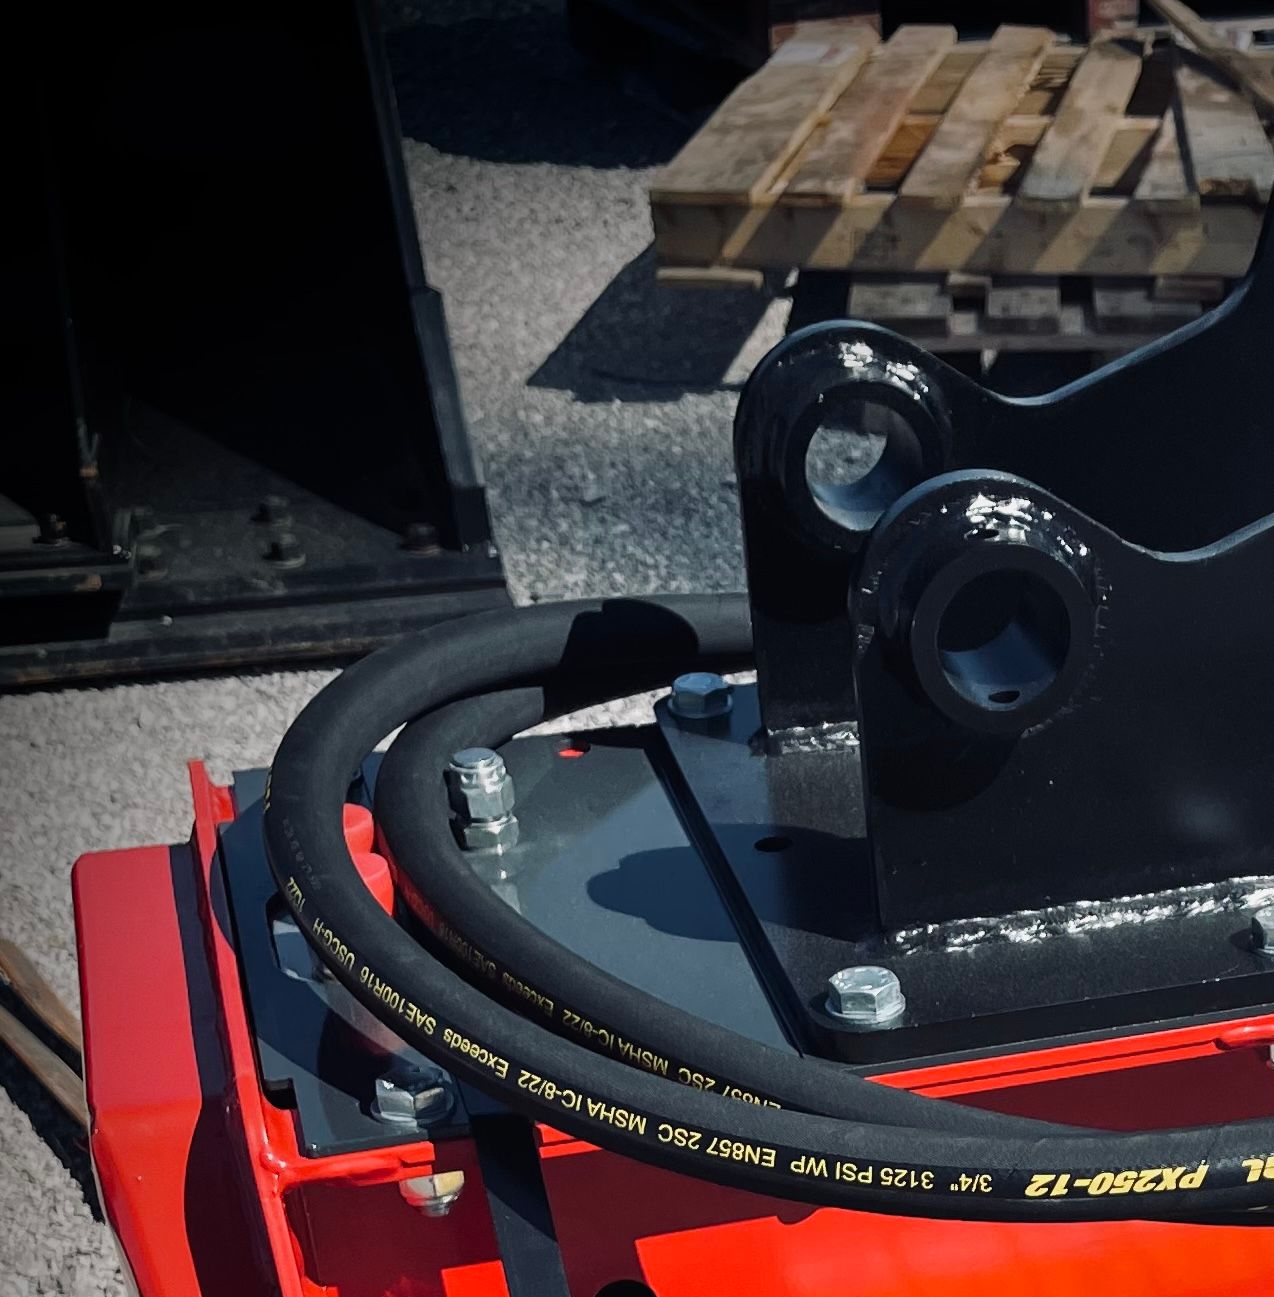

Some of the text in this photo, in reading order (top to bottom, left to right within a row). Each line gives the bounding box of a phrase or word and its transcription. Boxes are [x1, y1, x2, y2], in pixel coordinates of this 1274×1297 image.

[312, 917, 356, 970] USCG-H
[358, 965, 437, 1036] SAE100R16
[561, 1008, 619, 1050] IC-8/22
[443, 1027, 510, 1080] Exceeds
[619, 1037, 669, 1077] MSHA
[518, 1069, 583, 1111] IC-8/22
[586, 1097, 648, 1135] MSHA
[658, 1123, 702, 1150] 2SC
[706, 1136, 777, 1168] EN857
[790, 1157, 828, 1178] WP
[835, 1162, 873, 1184] PSI
[879, 1166, 935, 1190] 3125
[949, 1173, 993, 1193] 3/4"
[1024, 1162, 1208, 1197] PX250-12
